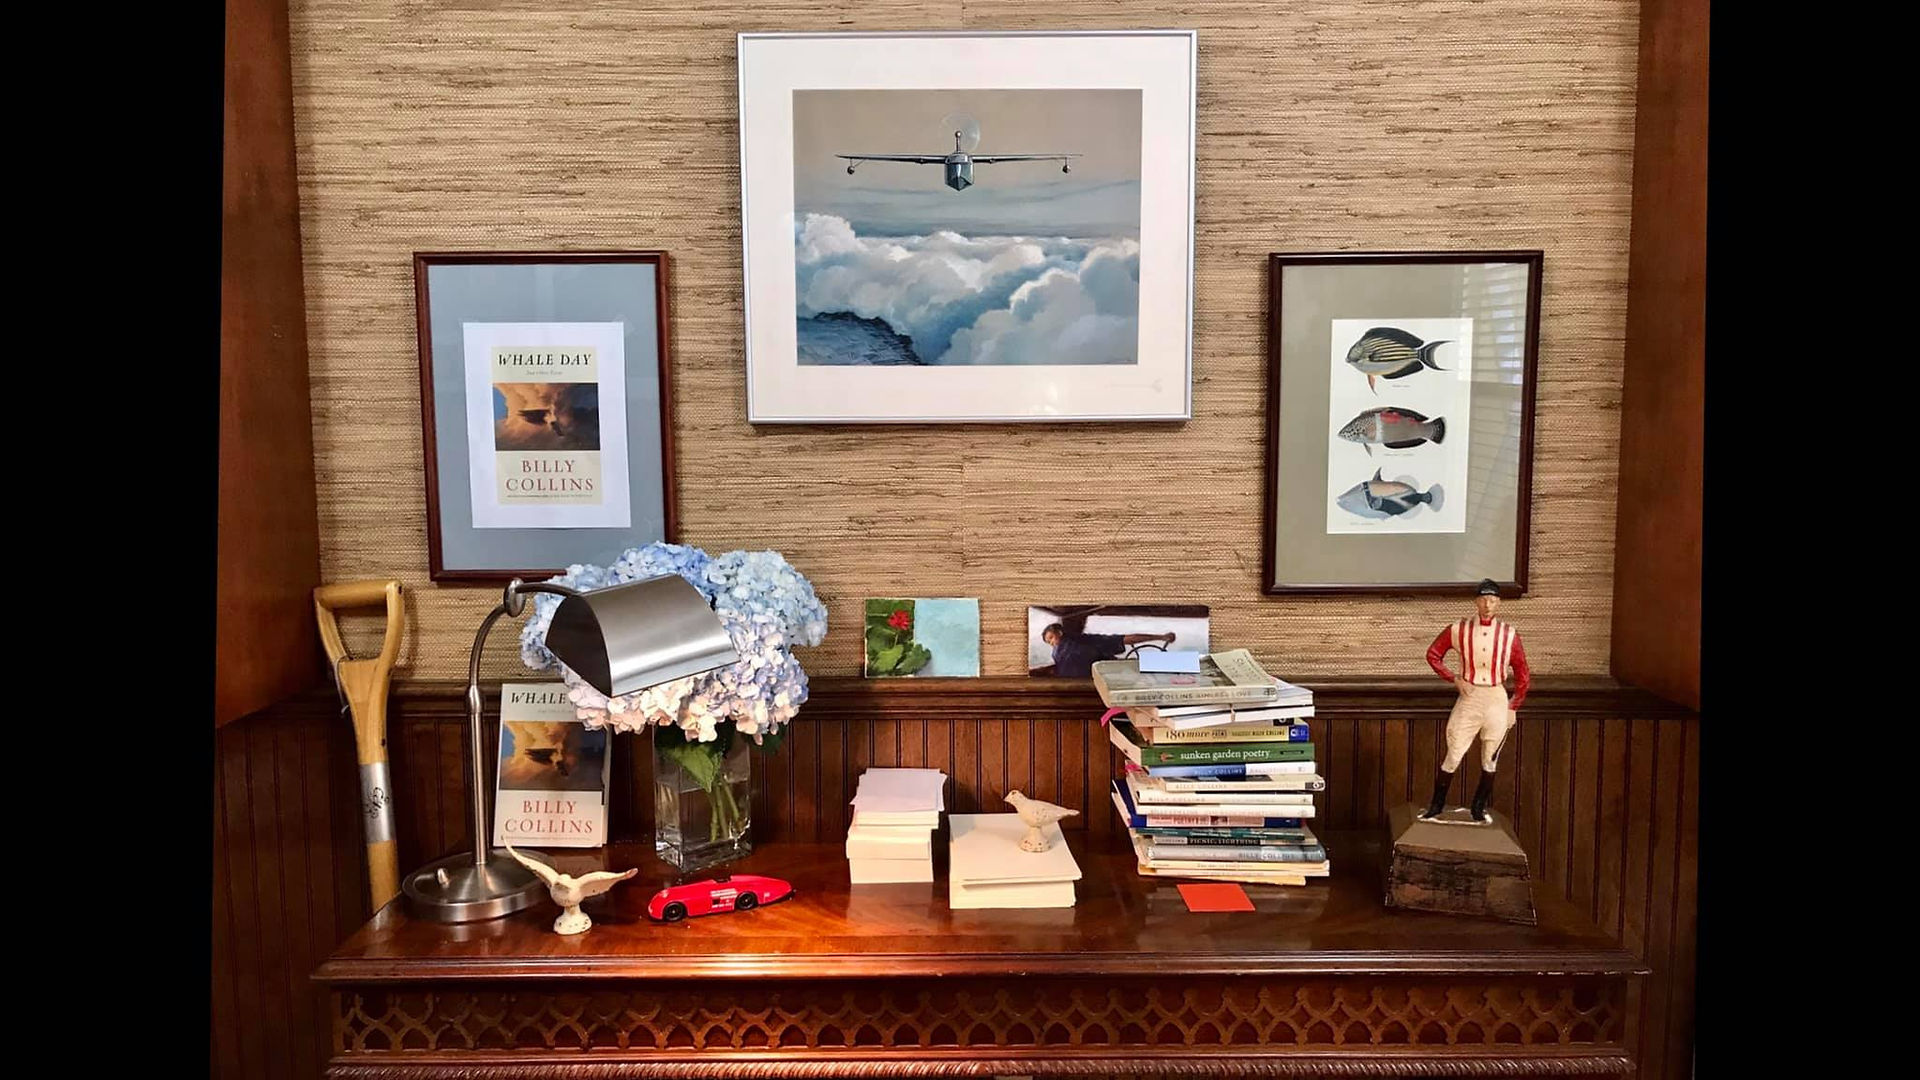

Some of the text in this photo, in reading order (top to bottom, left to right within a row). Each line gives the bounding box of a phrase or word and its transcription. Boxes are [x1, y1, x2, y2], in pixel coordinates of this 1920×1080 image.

[498, 354, 591, 366] WHALE DAY
[522, 460, 575, 473] BILLY
[506, 478, 593, 491] COLLINS
[511, 692, 567, 704] WHALE
[1180, 749, 1270, 761] sunken garden poetry
[523, 800, 576, 814] BILLY
[505, 819, 593, 833] COLLINS
